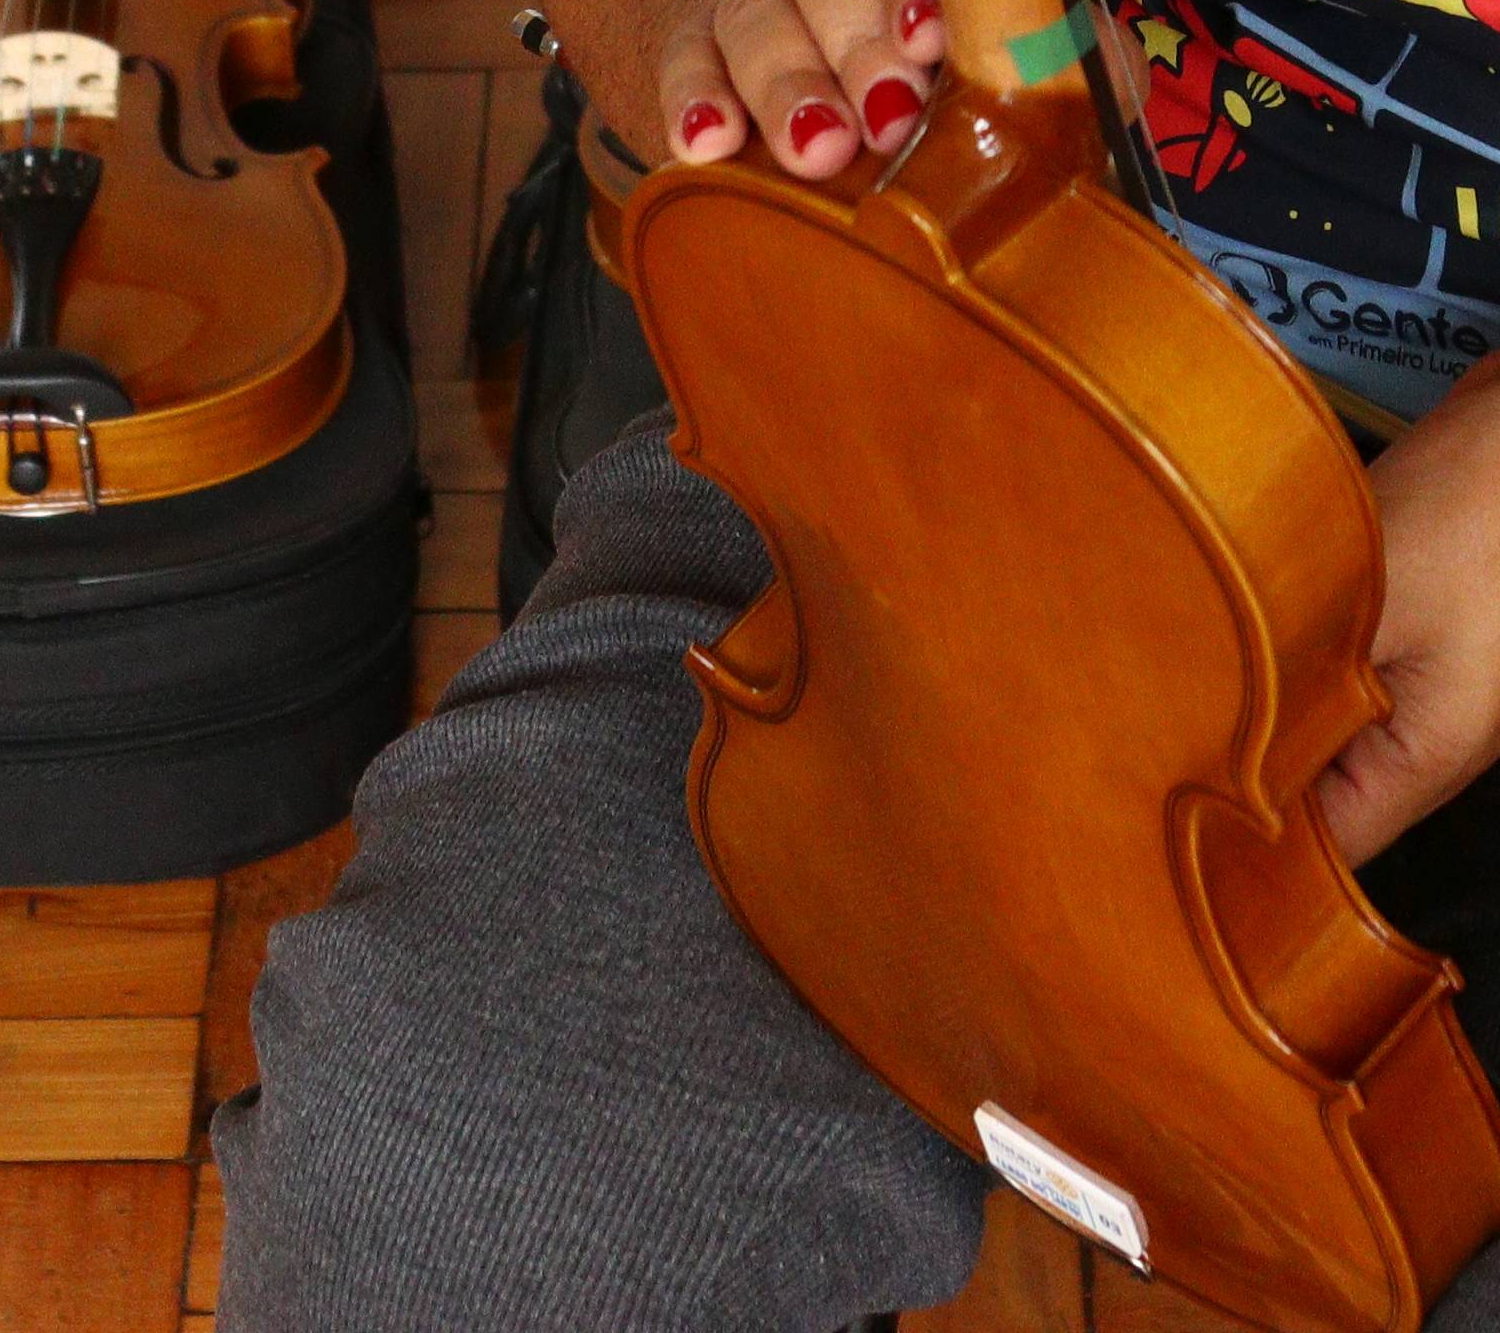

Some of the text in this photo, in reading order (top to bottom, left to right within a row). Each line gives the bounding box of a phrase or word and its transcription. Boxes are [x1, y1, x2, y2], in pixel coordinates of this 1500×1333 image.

[1301, 280, 1491, 356] Gente
[1308, 335, 1332, 349] em
[1337, 336, 1425, 372] Primeiro
